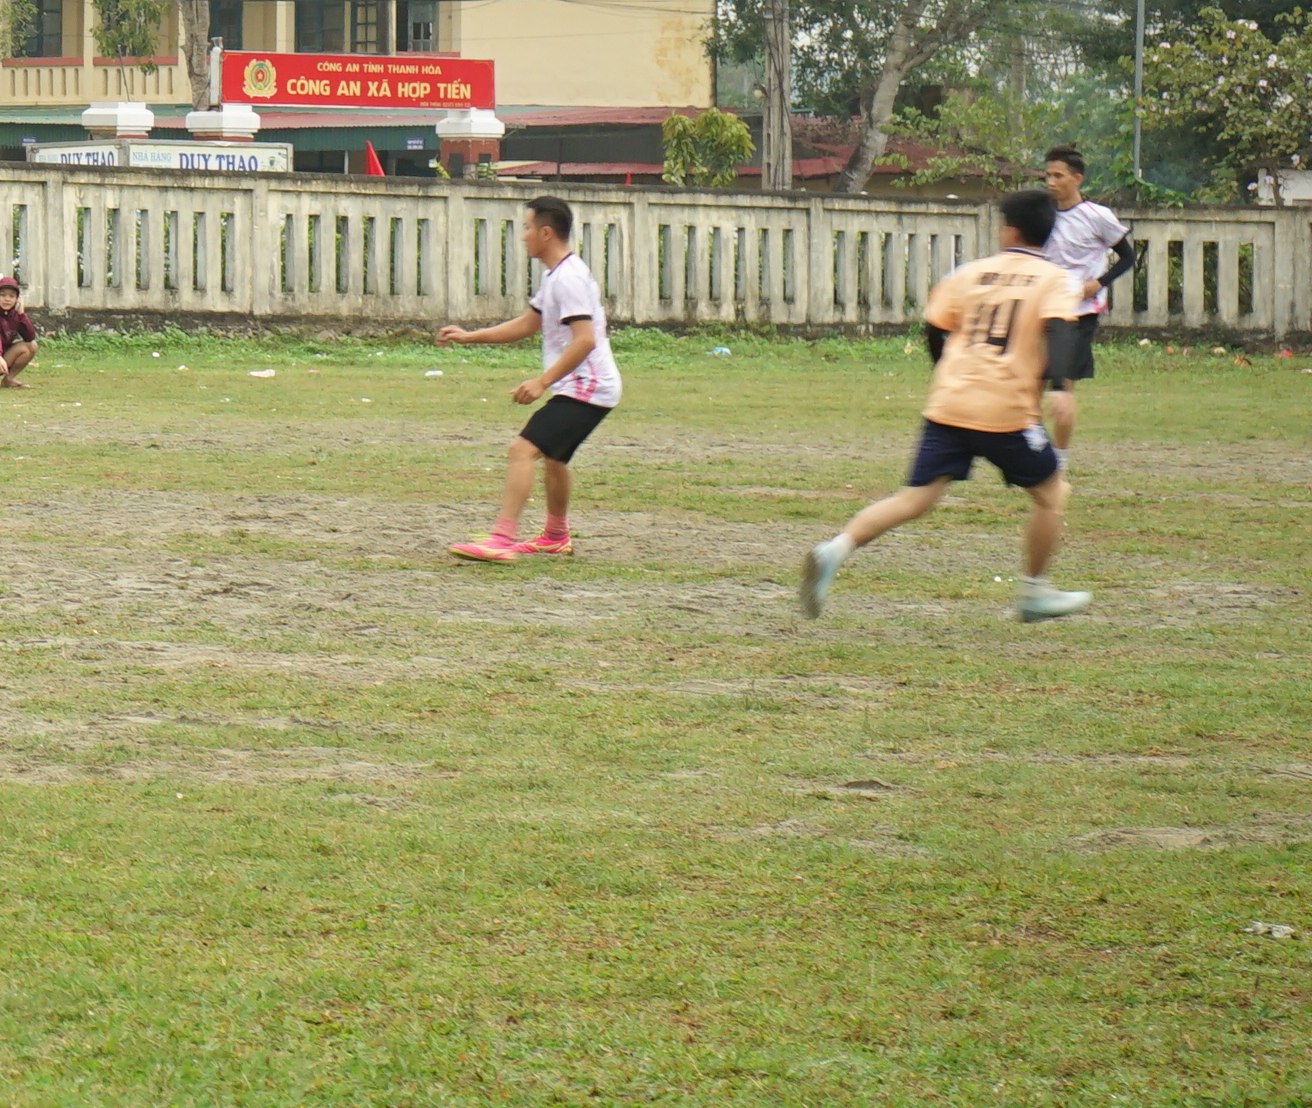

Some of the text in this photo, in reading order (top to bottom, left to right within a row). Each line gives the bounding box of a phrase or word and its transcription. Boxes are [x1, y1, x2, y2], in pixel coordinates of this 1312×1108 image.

[317, 61, 443, 76] CÔNG AN TỈNH THANH HÓA
[287, 76, 471, 102] CÔNG AN XÃ HỢP TIẾN
[60, 152, 83, 166] DUY
[179, 152, 212, 169] DUY
